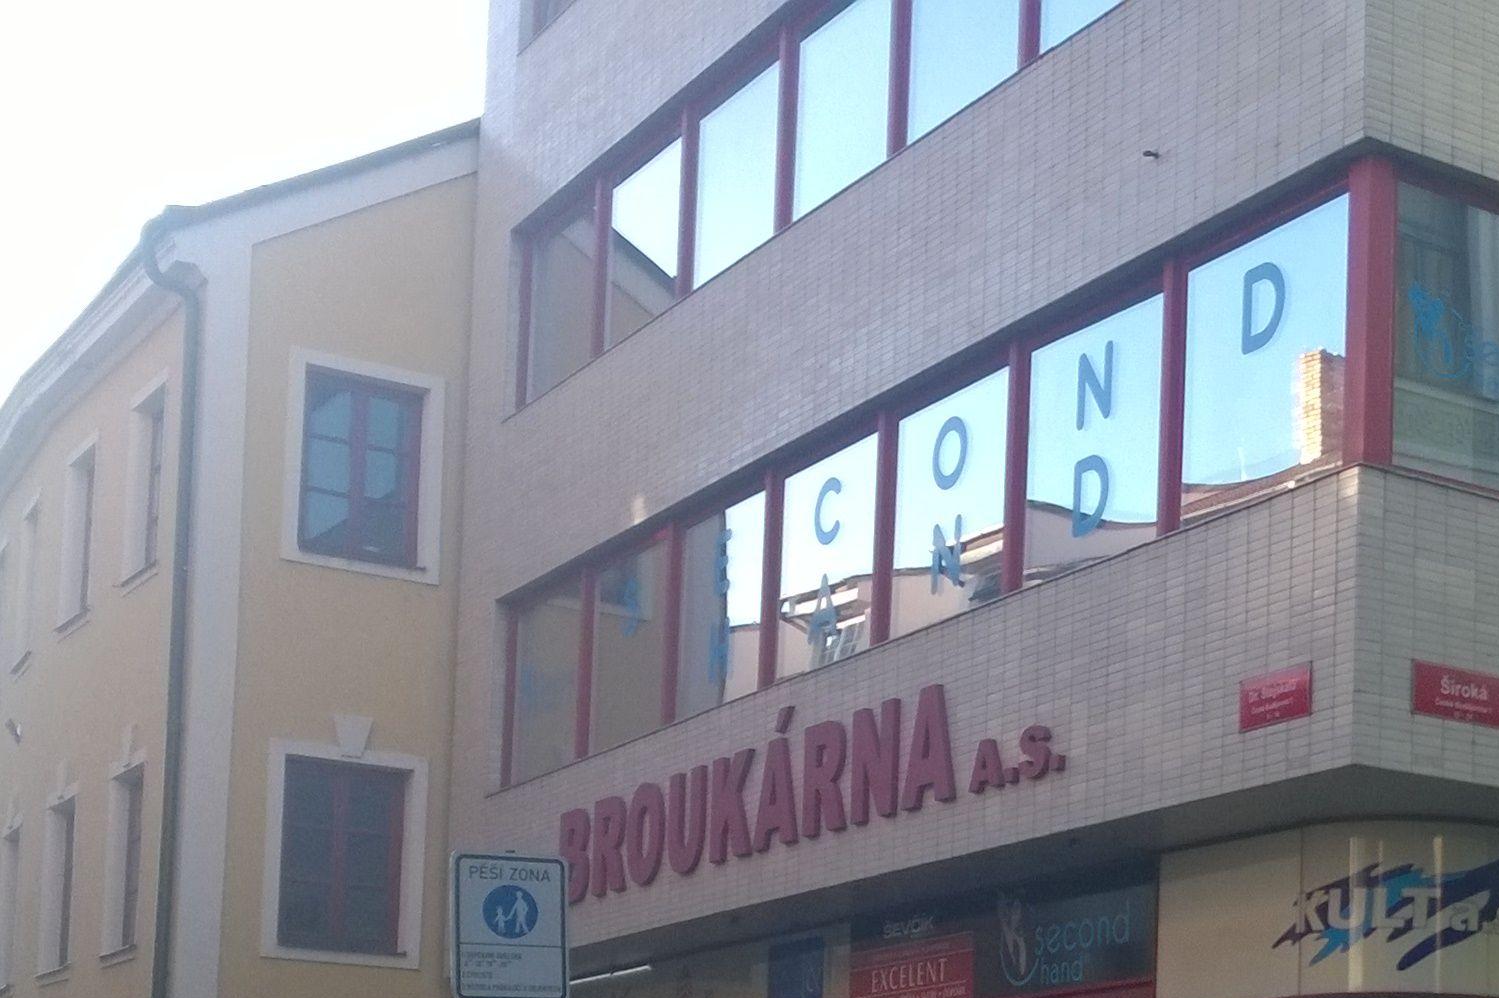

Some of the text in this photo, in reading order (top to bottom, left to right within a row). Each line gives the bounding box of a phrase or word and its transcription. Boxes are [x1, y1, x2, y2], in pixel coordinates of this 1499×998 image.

[1440, 675, 1488, 701] Široká
[559, 684, 956, 906] BROUKÁRNA
[1035, 900, 1130, 956] second
[871, 957, 948, 993] EXCELENT
[1040, 954, 1084, 985] hand
